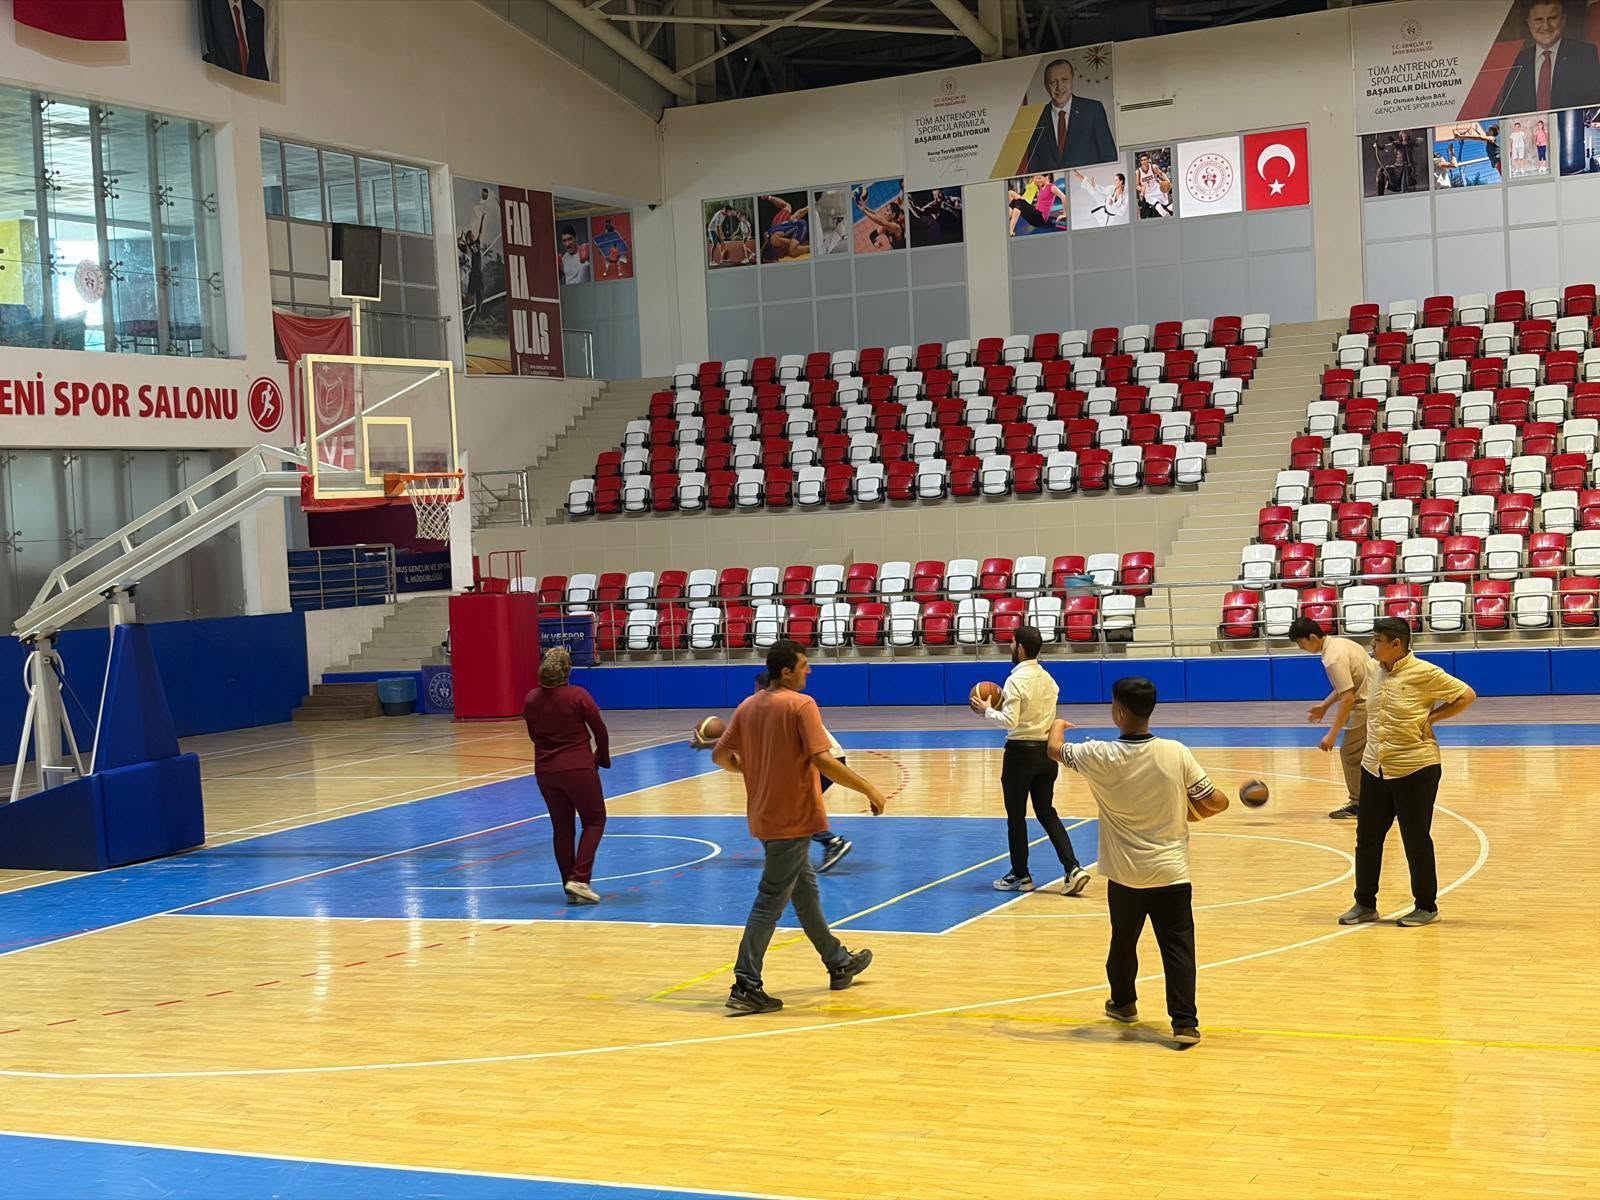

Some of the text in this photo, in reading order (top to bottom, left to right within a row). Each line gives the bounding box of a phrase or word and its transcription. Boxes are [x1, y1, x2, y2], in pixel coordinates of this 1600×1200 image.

[1368, 57, 1459, 76] TÜM ANTRENÖR VE
[1372, 68, 1456, 86] SPORCULARIMIZA
[1366, 78, 1462, 97] BAŞARILAR DİLİYORUM
[916, 108, 988, 126] TÜM ANTRENÖR VE
[1375, 105, 1404, 116] GENÇLİK
[1412, 102, 1430, 110] SPOR
[914, 127, 990, 144] BAŞARILAR DİLİYORUM
[918, 118, 986, 136] SPORCULARIMIZA
[504, 200, 532, 246] FAR
[512, 310, 550, 360] ULAŞ
[0, 372, 238, 420] ENİ SPOR SALONU
[562, 632, 584, 641] SPOR
